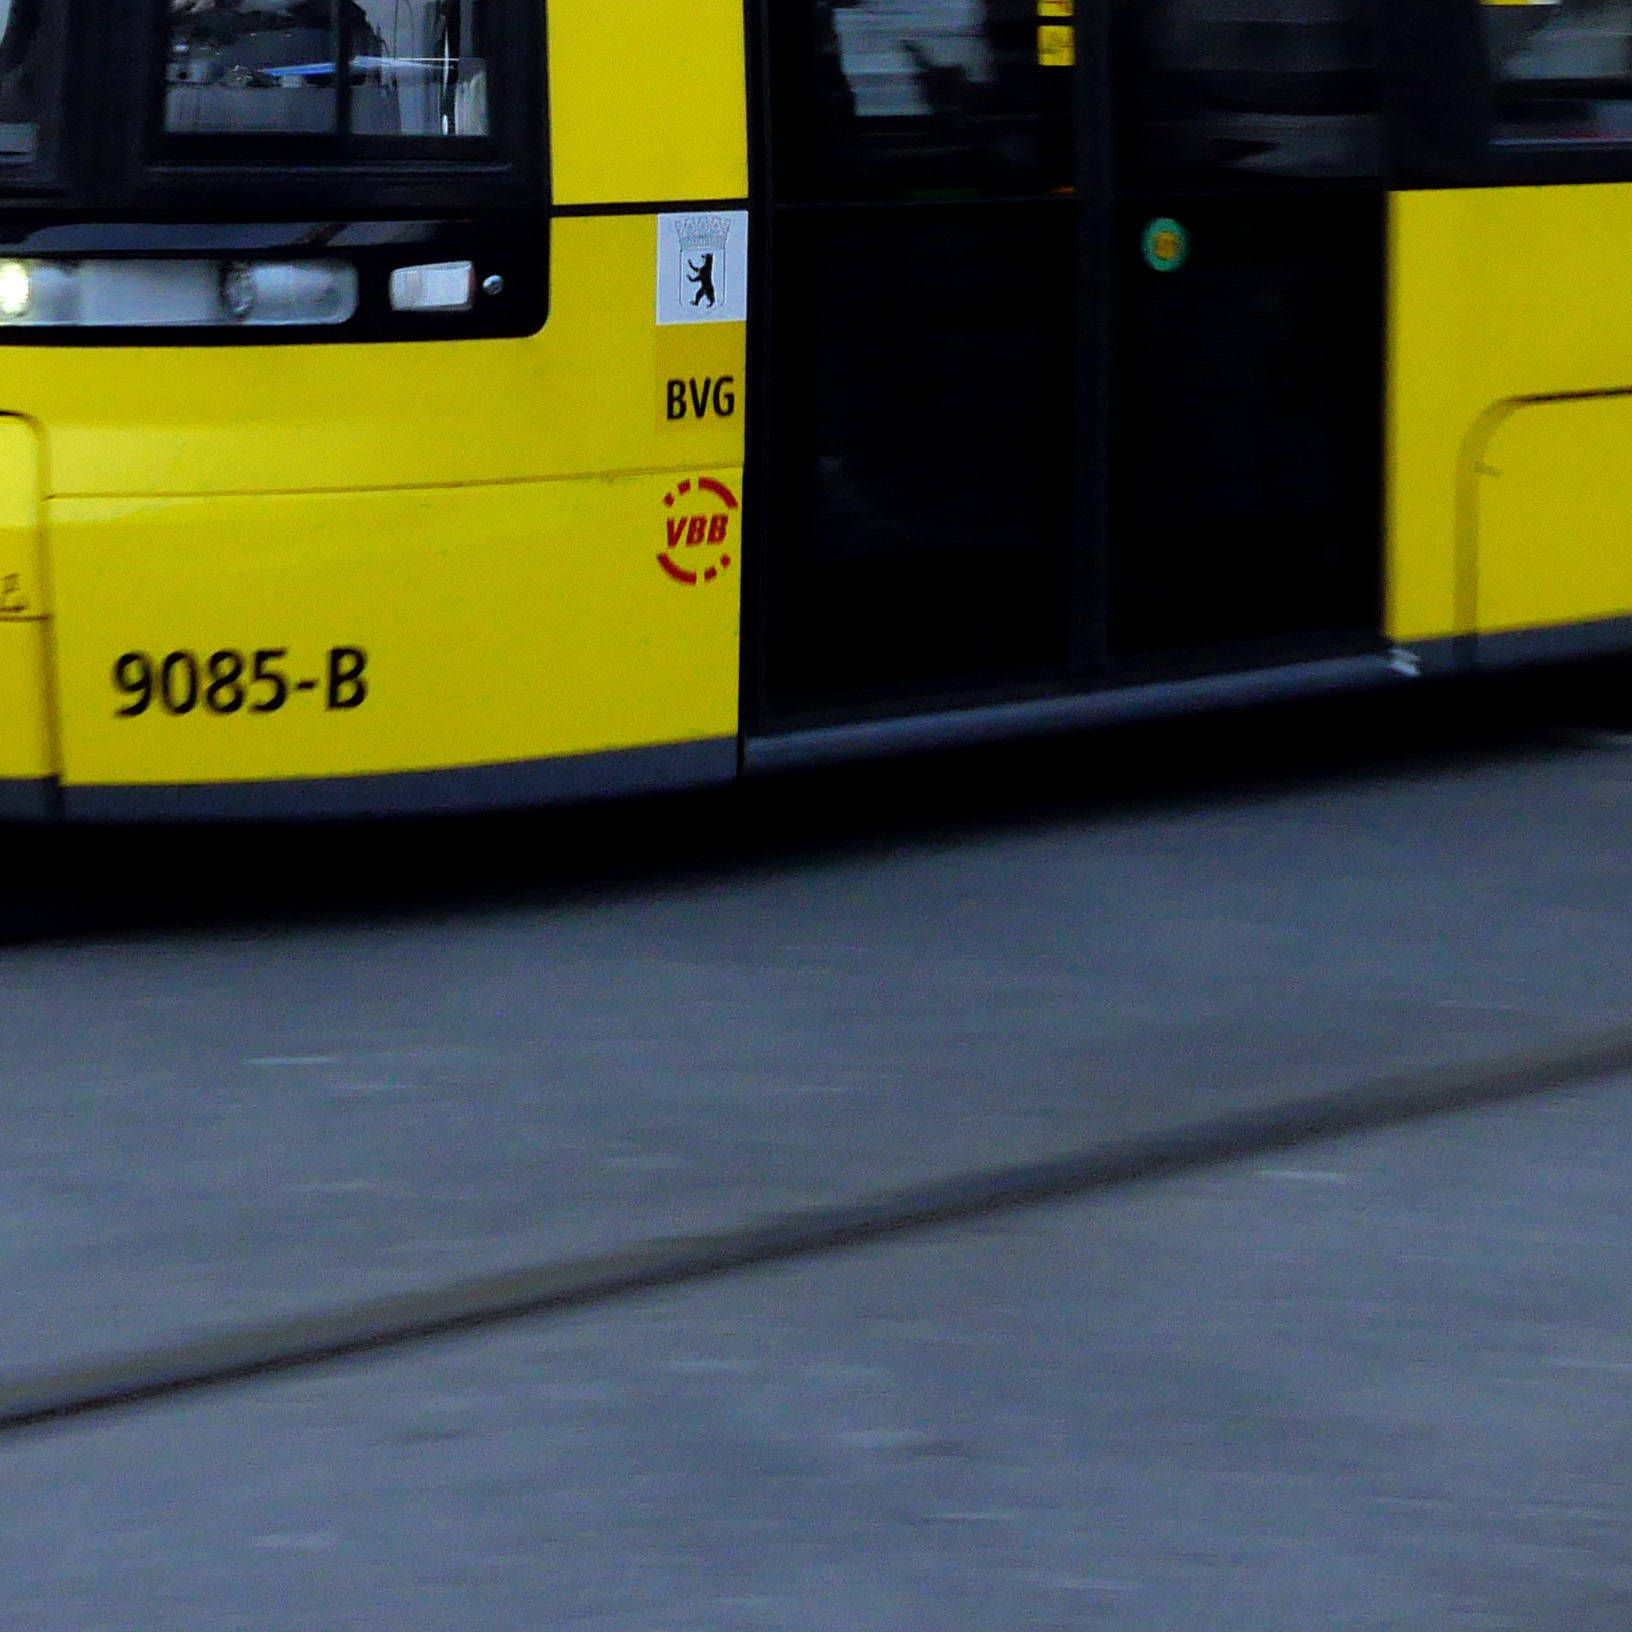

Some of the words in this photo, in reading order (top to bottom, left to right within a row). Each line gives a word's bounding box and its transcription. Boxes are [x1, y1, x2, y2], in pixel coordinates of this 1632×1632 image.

[667, 376, 735, 420] BVG
[666, 514, 729, 548] VBB
[112, 646, 367, 718] 9085-B
